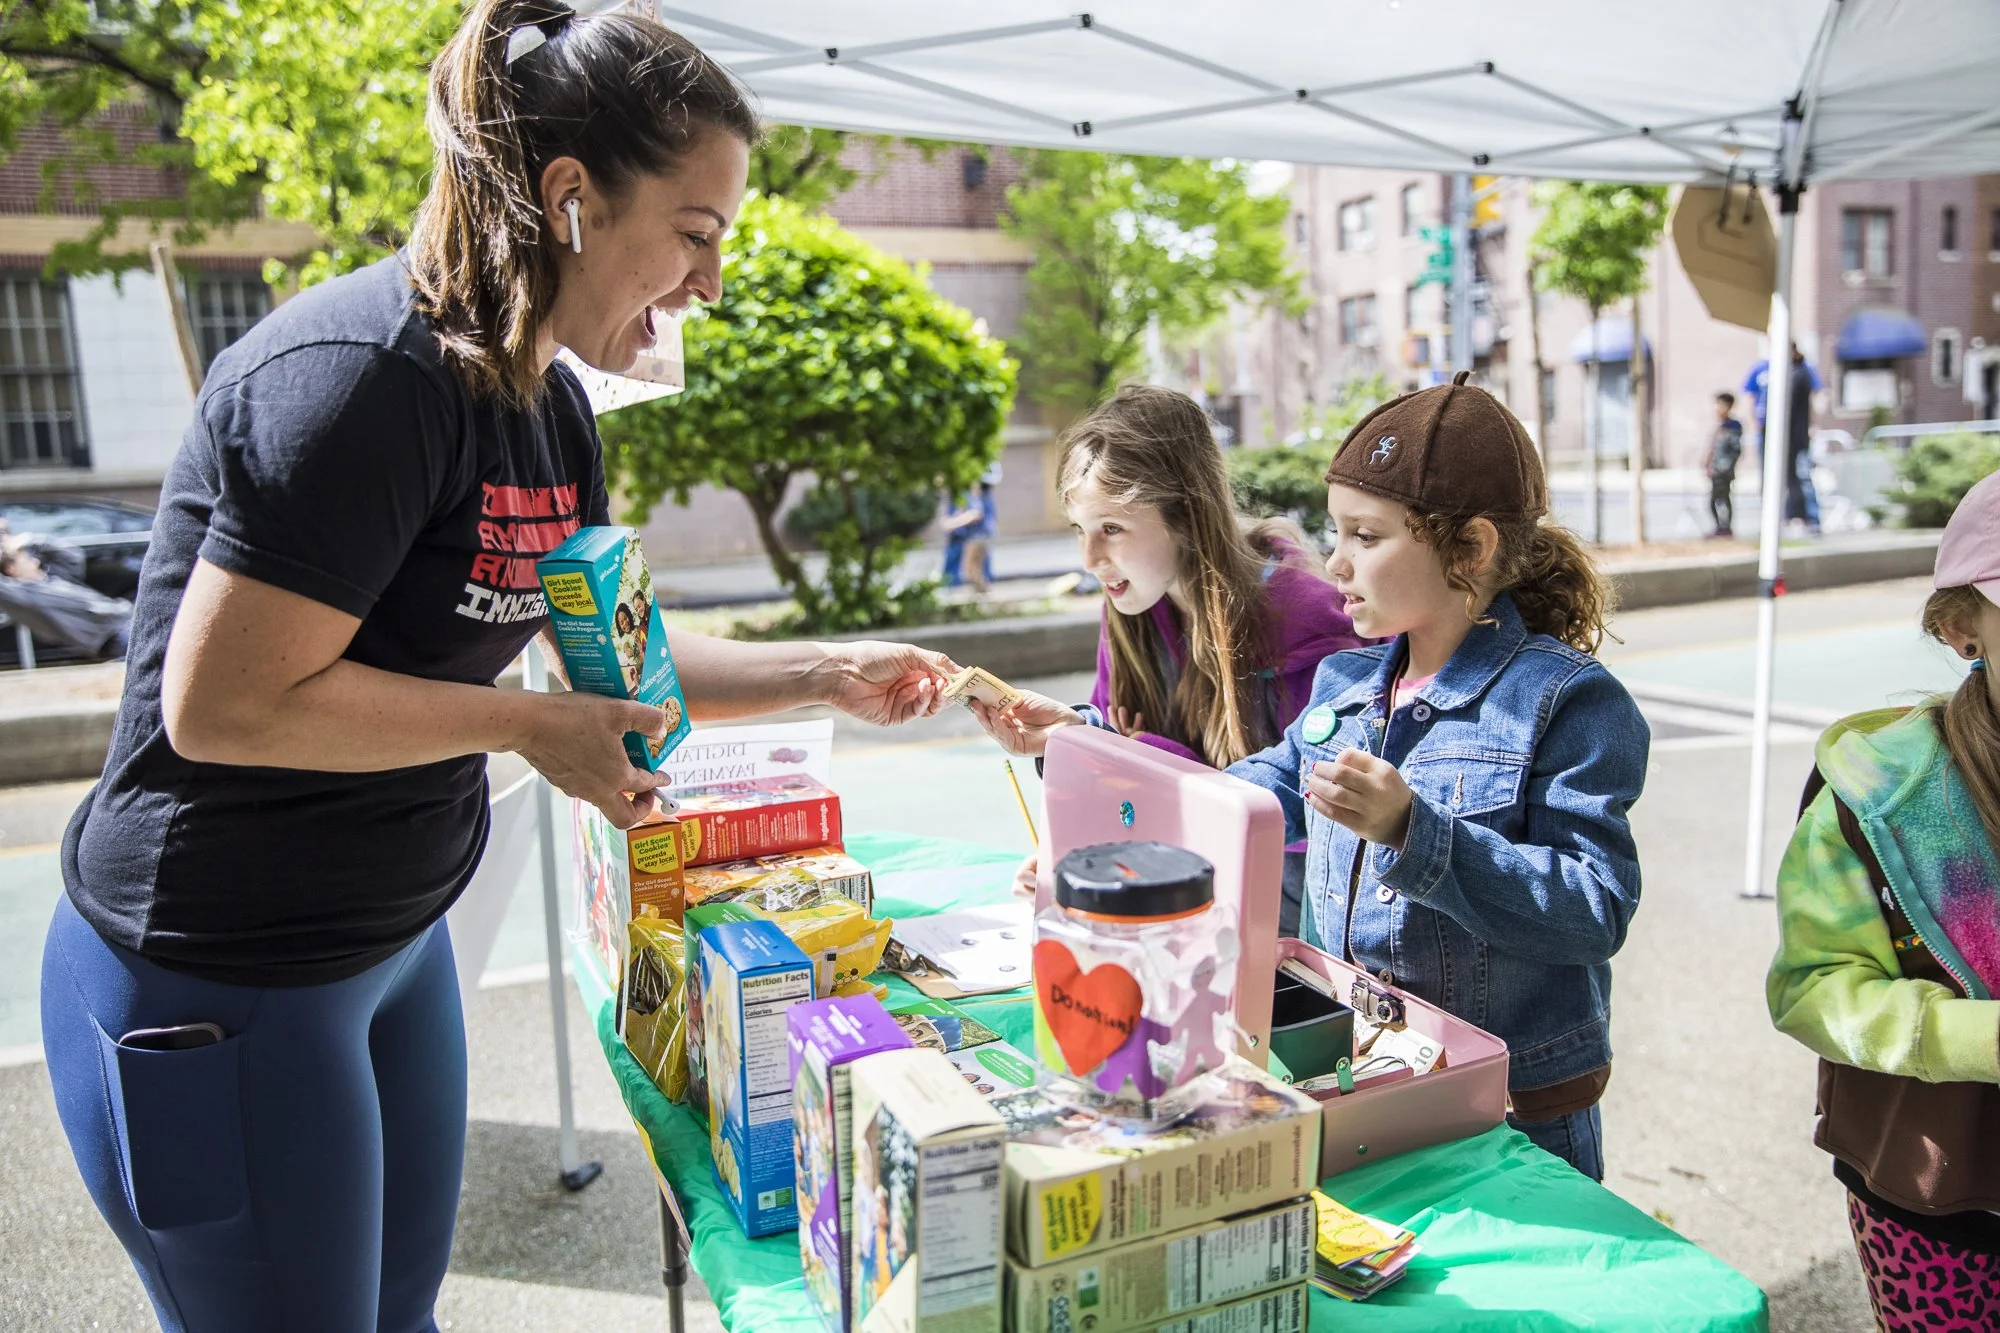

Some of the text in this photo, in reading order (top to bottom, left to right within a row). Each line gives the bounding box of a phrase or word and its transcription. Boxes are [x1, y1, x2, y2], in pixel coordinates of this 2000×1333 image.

[547, 577, 583, 587] Girl Scout
[553, 585, 583, 594] Cookies
[553, 592, 582, 602] proceeds
[575, 598, 594, 607] local.
[634, 835, 671, 849] Girl Scout
[639, 843, 668, 854] Cookies
[637, 851, 667, 864] proceeds
[644, 855, 676, 868] stay local.
[743, 972, 809, 989] Nutrition Facts
[745, 1008, 772, 1017] Calories
[1414, 1046, 1434, 1066] 10
[1300, 1206, 1309, 1274] Nutrition Facts
[1291, 1289, 1300, 1329] Nutrition
